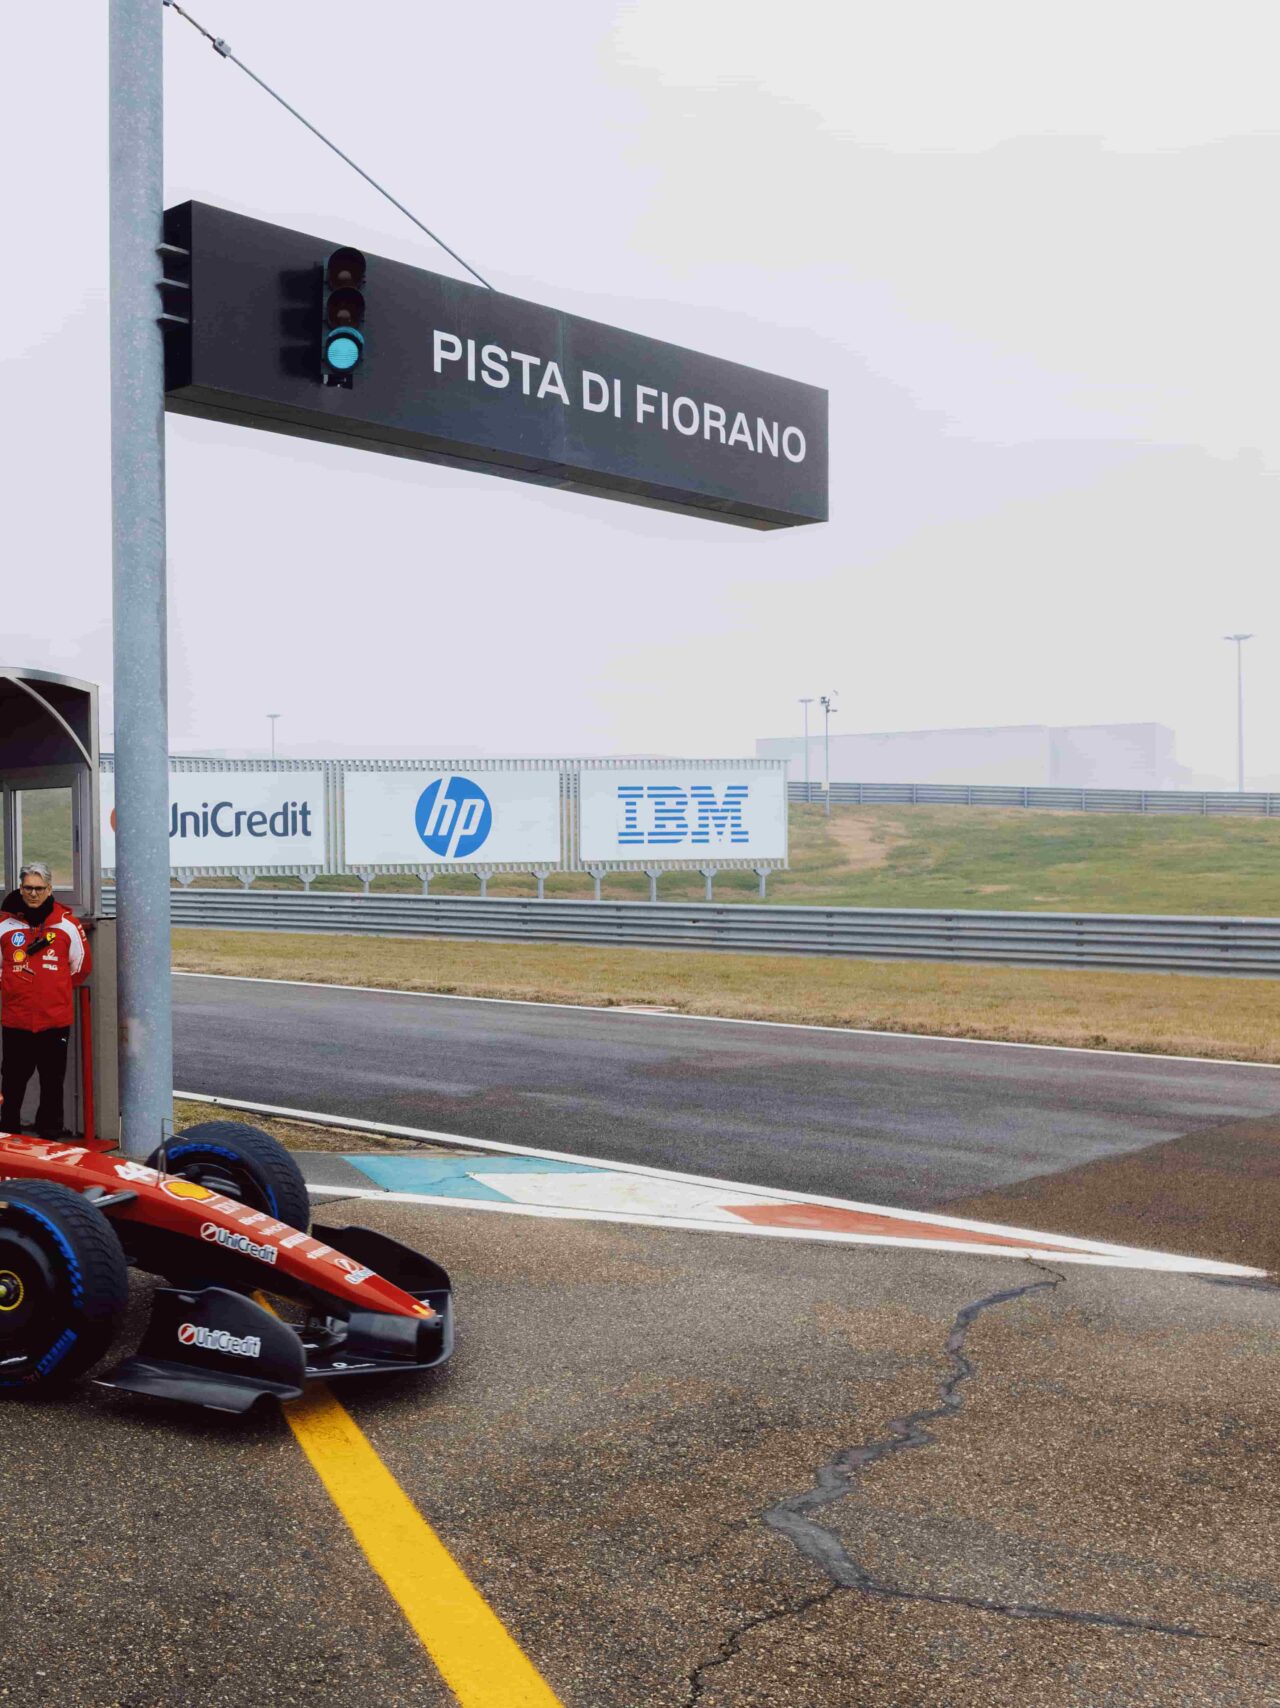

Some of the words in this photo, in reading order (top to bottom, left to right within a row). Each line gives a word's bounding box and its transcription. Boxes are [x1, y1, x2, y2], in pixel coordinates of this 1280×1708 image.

[433, 329, 570, 406] PISTA
[582, 369, 622, 418] DI
[636, 385, 808, 463] FIORANO
[422, 776, 486, 858] hp
[617, 785, 749, 845] IBM
[217, 1228, 277, 1263] UniCredit
[196, 1327, 261, 1357] UniCredit
